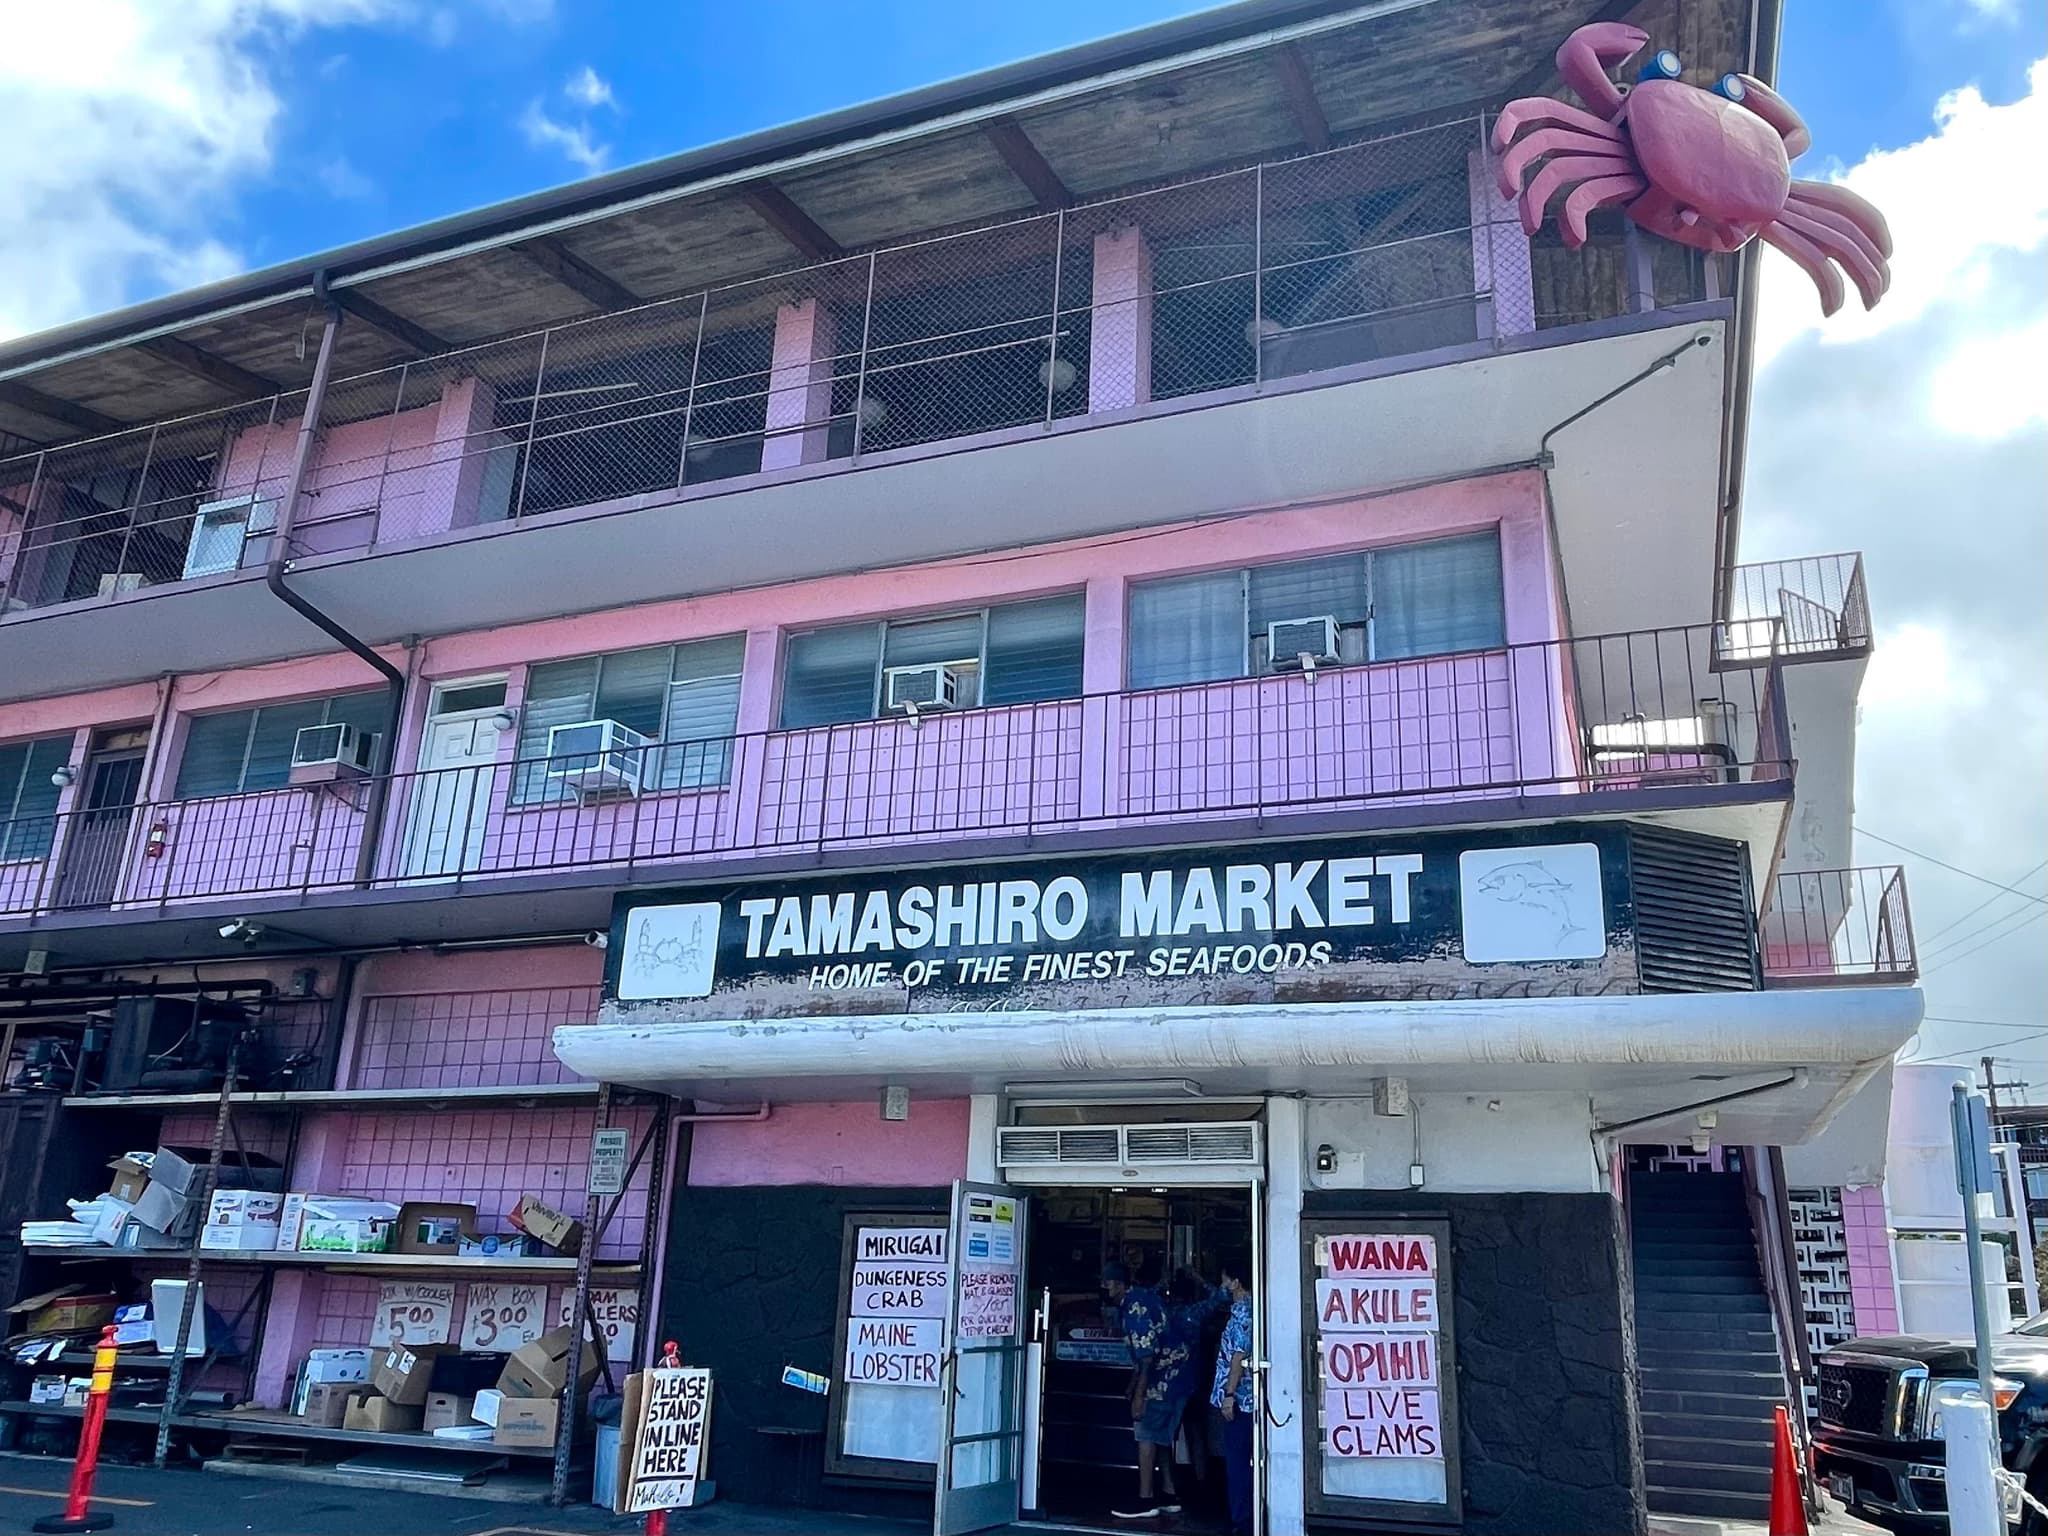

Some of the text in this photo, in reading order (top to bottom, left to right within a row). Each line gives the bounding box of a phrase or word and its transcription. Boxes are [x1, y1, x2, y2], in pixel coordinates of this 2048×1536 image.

[740, 853, 1424, 959] TAMASHIRO MARKET
[808, 941, 1333, 991] HOME OF THE FINEST SEAFOODS
[865, 1234, 942, 1258] MIRUGAI
[1330, 1241, 1428, 1271] WANA
[855, 1270, 947, 1287] DUNGENESS
[961, 1274, 988, 1287] PLEASE
[470, 1286, 537, 1307] WAX BOX
[866, 1290, 923, 1309] CRAB
[1323, 1288, 1432, 1324] AKULE
[562, 1305, 638, 1323] CLERS
[858, 1323, 918, 1346] MAINE
[850, 1352, 937, 1382] LOBSTER
[1328, 1340, 1430, 1382] OPIHI
[653, 1376, 706, 1400] PLEASE
[650, 1400, 701, 1421] STAND
[1343, 1391, 1424, 1420] LIVE
[644, 1422, 701, 1448] IN LINE
[1332, 1424, 1436, 1456] CLAMS
[643, 1448, 688, 1473] HERE
